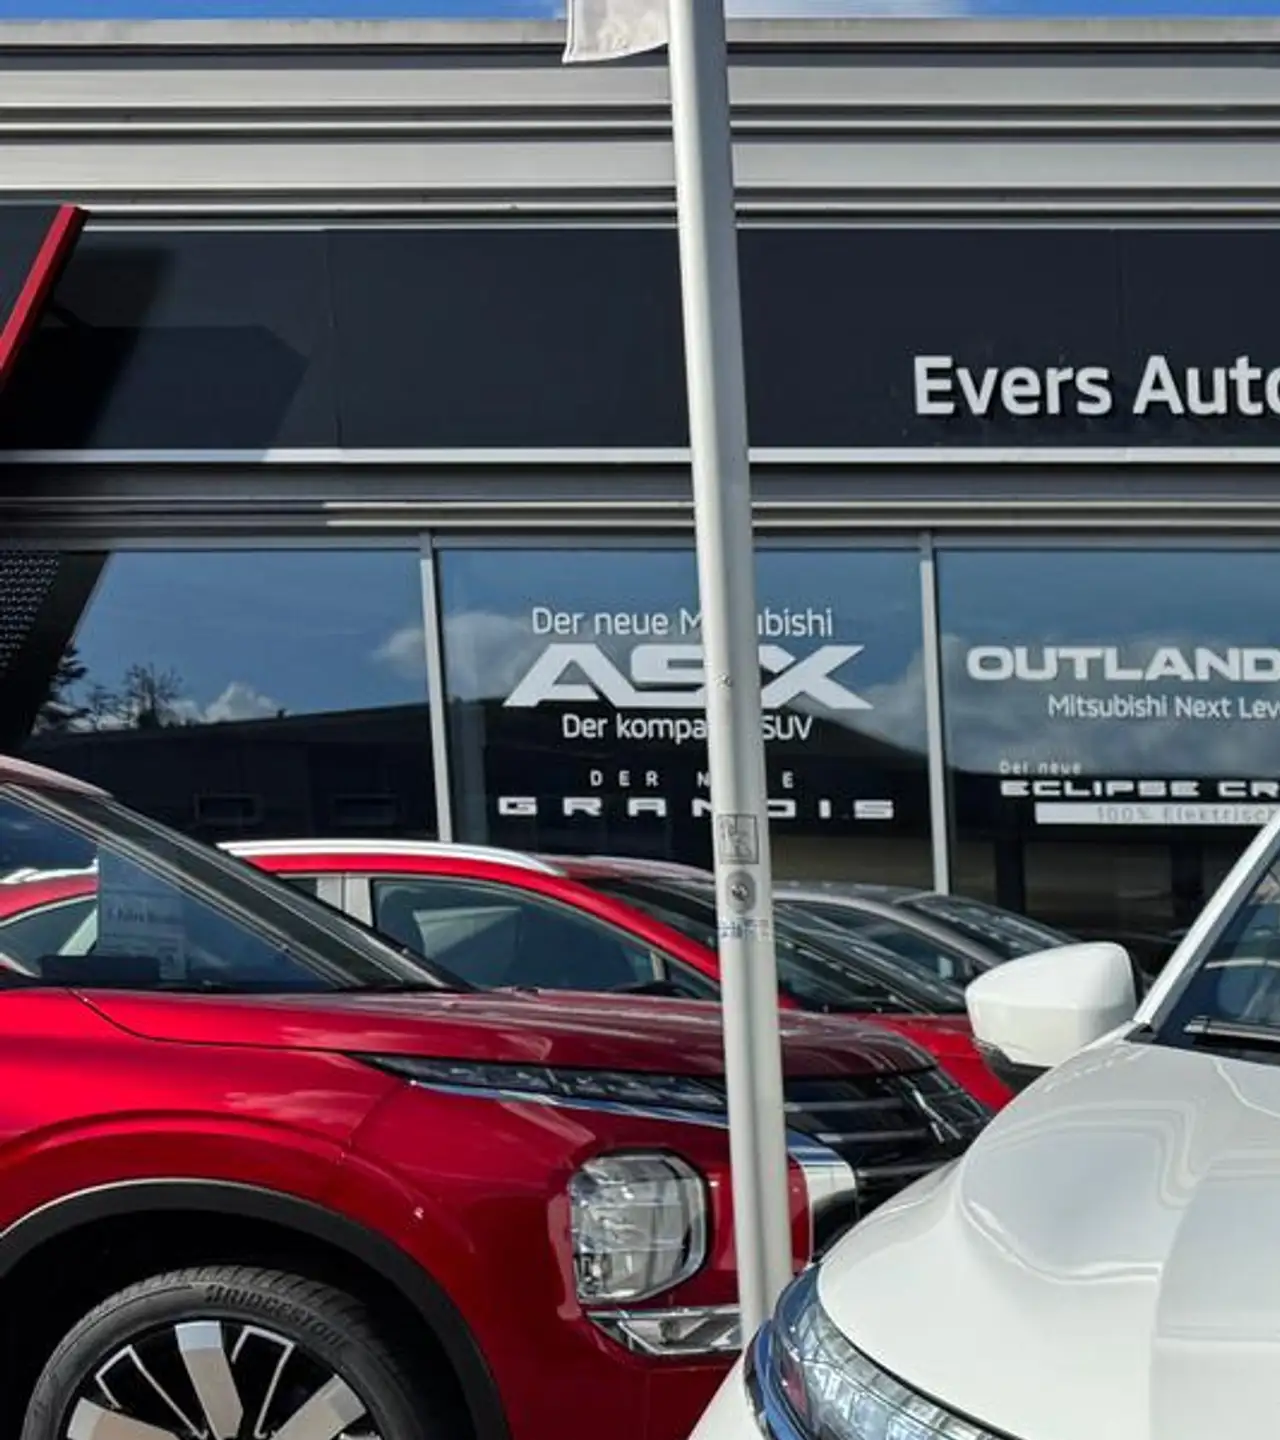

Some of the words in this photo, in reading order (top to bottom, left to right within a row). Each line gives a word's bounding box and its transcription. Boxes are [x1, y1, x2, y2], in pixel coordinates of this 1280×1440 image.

[913, 354, 1112, 417] Evers
[532, 609, 583, 635] Der
[594, 615, 668, 636] neue
[680, 607, 833, 637] Mbishi
[503, 643, 875, 709] ASX
[1048, 694, 1167, 719] Mitsubishi
[1174, 696, 1231, 719] Next
[562, 714, 605, 739] Der
[616, 714, 709, 745] kompa
[762, 715, 813, 741] SUV
[590, 770, 660, 788] DER
[1001, 780, 1200, 797] ECLIPSE
